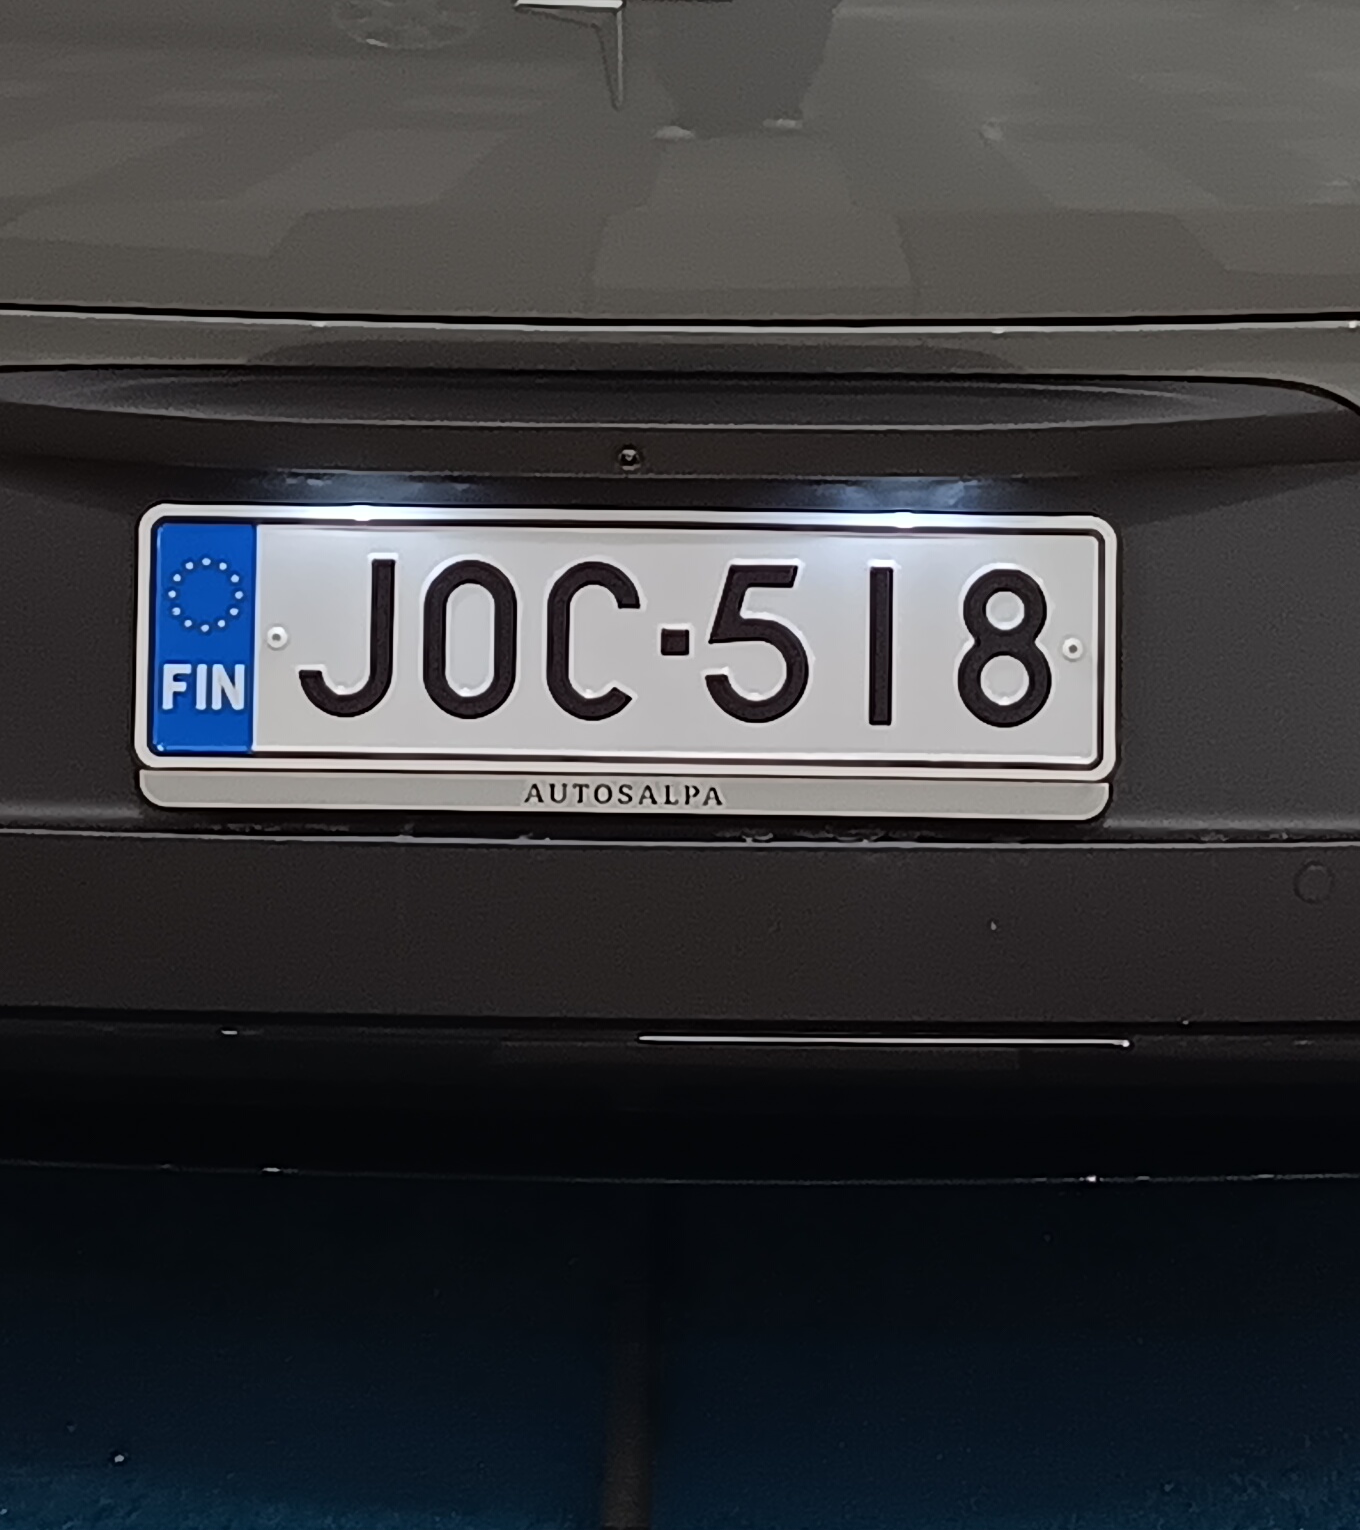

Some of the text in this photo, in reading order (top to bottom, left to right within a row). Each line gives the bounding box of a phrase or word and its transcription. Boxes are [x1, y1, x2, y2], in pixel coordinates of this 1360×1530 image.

[298, 558, 1053, 728] JOC-518
[161, 663, 246, 711] FIN
[523, 781, 724, 808] AUTOSALPA
